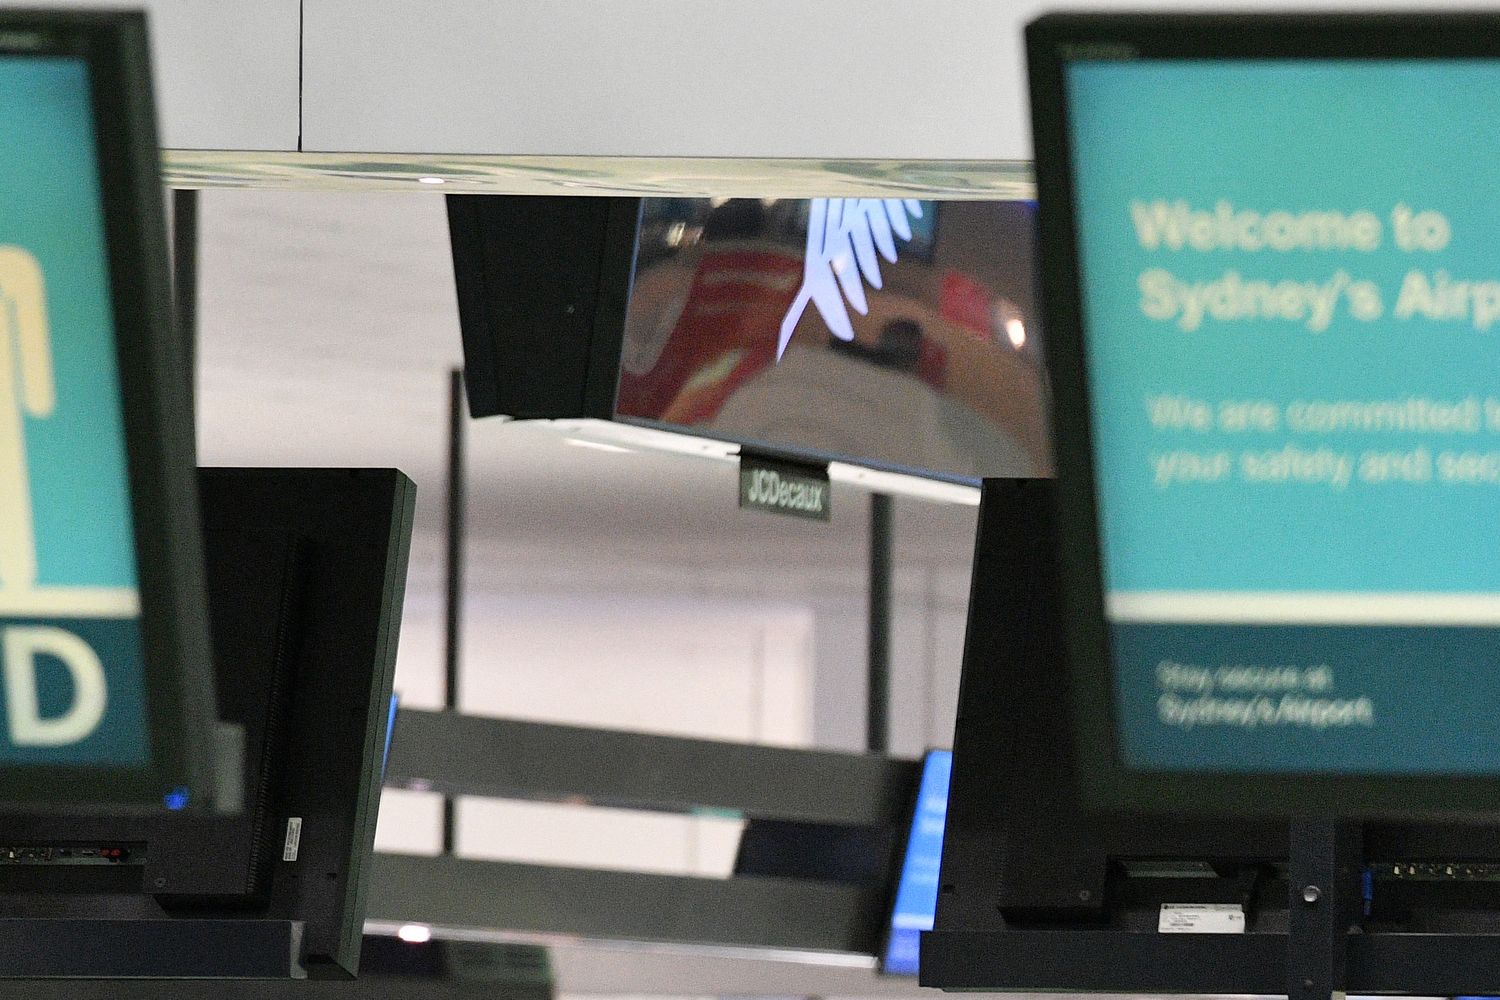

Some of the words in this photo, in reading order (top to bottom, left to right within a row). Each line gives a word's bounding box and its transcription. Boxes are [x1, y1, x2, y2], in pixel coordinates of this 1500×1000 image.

[1130, 199, 1382, 251] Welcome
[1392, 201, 1452, 252] to
[1138, 268, 1383, 332] Sydney's
[1147, 395, 1212, 433] We
[1219, 400, 1279, 433] are
[1286, 395, 1481, 433] committed
[1154, 450, 1230, 489] your
[1241, 445, 1352, 489] safety
[1359, 446, 1433, 483] and
[747, 468, 823, 512] JCDecaux
[1156, 660, 1214, 697] Stay
[1216, 664, 1299, 692] secure
[1303, 664, 1334, 691] at
[1156, 691, 1274, 730] Sydney's
